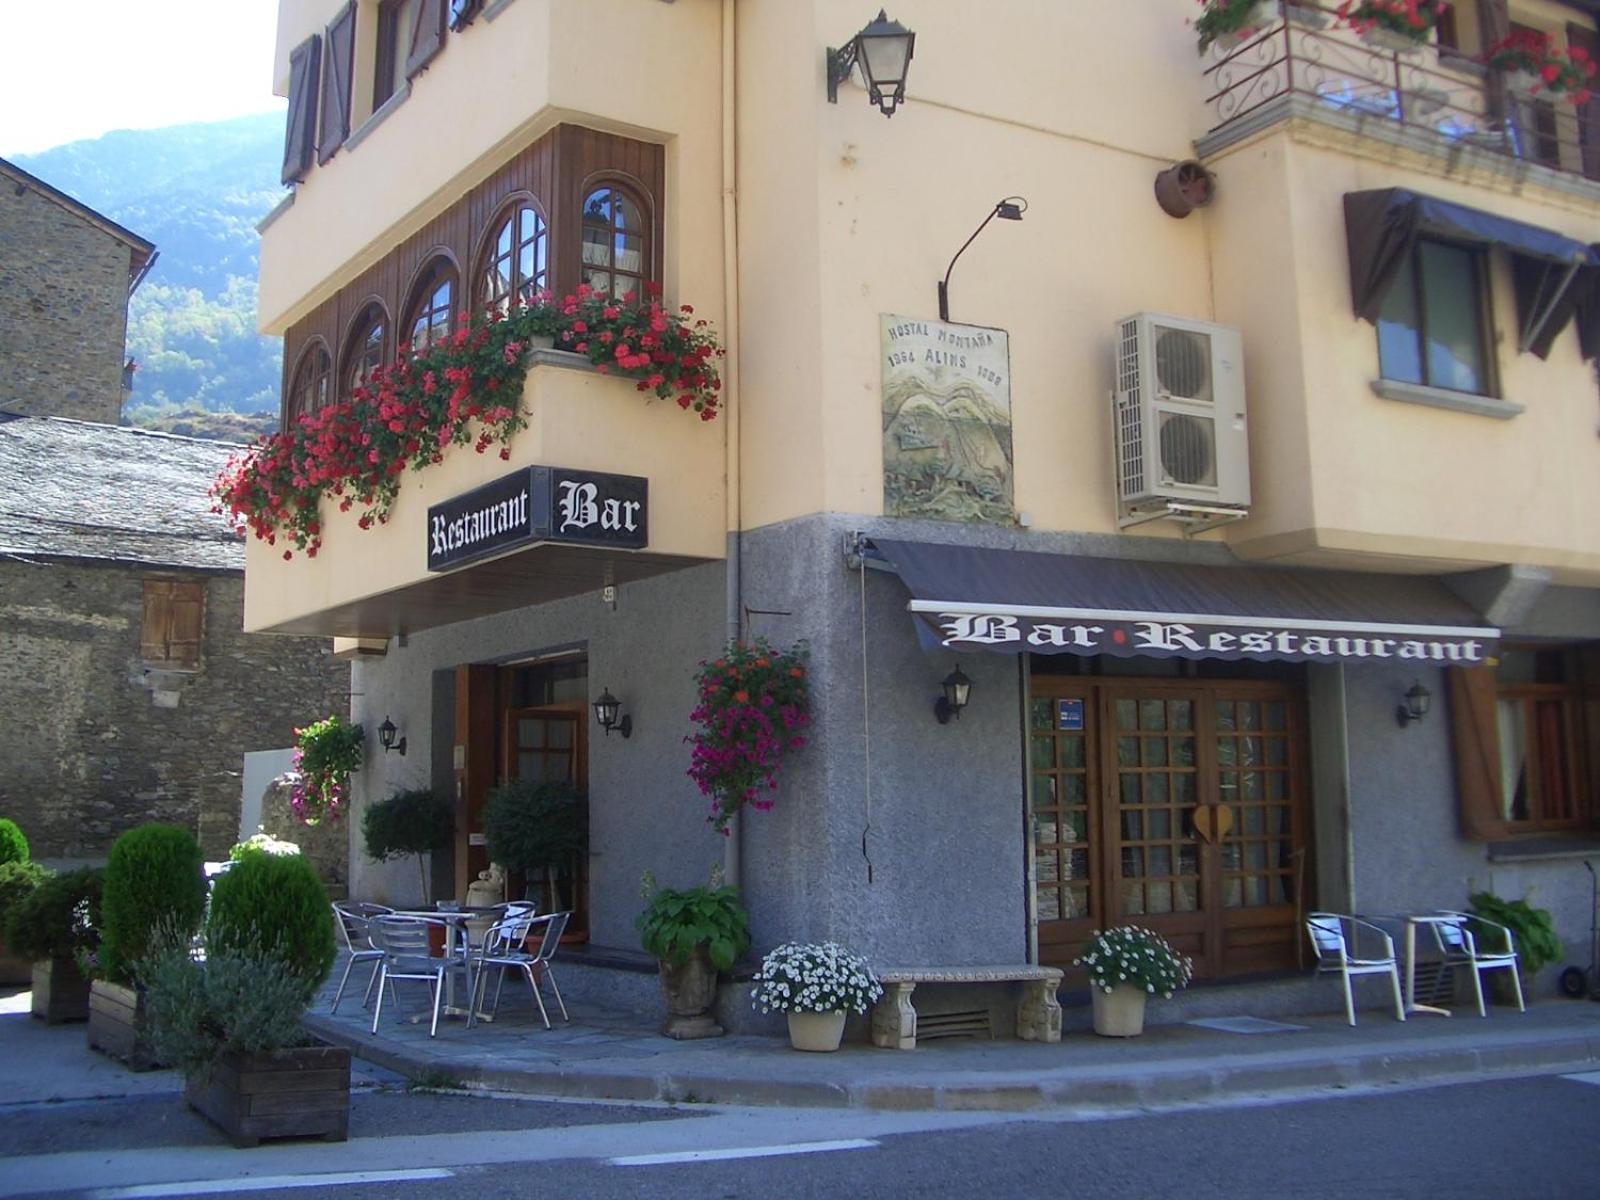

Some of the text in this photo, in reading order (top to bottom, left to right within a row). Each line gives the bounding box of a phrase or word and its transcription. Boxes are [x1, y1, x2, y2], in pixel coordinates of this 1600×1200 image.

[888, 323, 928, 340] HOSTAL
[925, 349, 966, 368] ALINS
[431, 489, 528, 554] Restaurant
[559, 480, 640, 533] Bar
[938, 613, 1482, 661] Bar Restaurant
